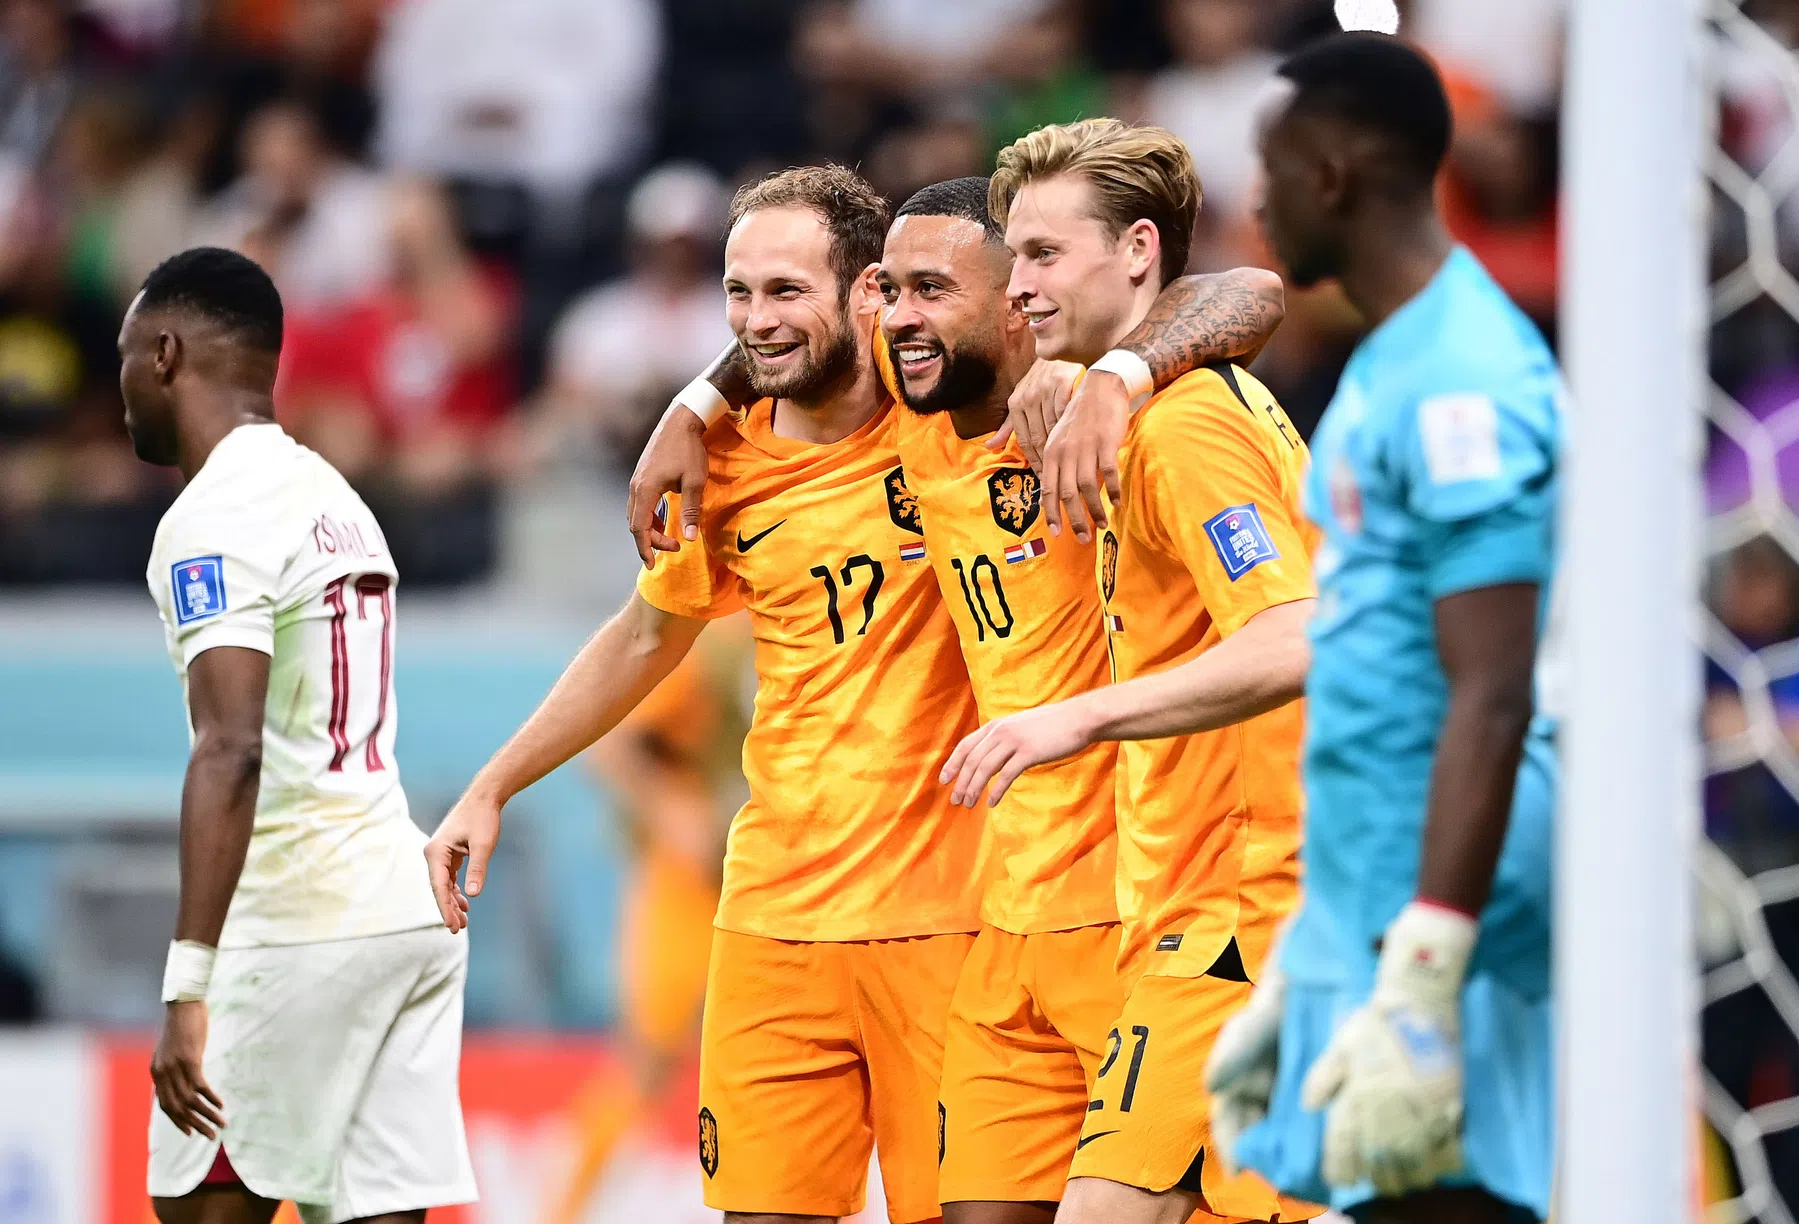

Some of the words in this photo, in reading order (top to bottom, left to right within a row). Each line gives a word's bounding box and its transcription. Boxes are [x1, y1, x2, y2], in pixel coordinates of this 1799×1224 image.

[810, 554, 885, 644] 17
[951, 554, 1014, 642] 10
[323, 573, 389, 773] 17
